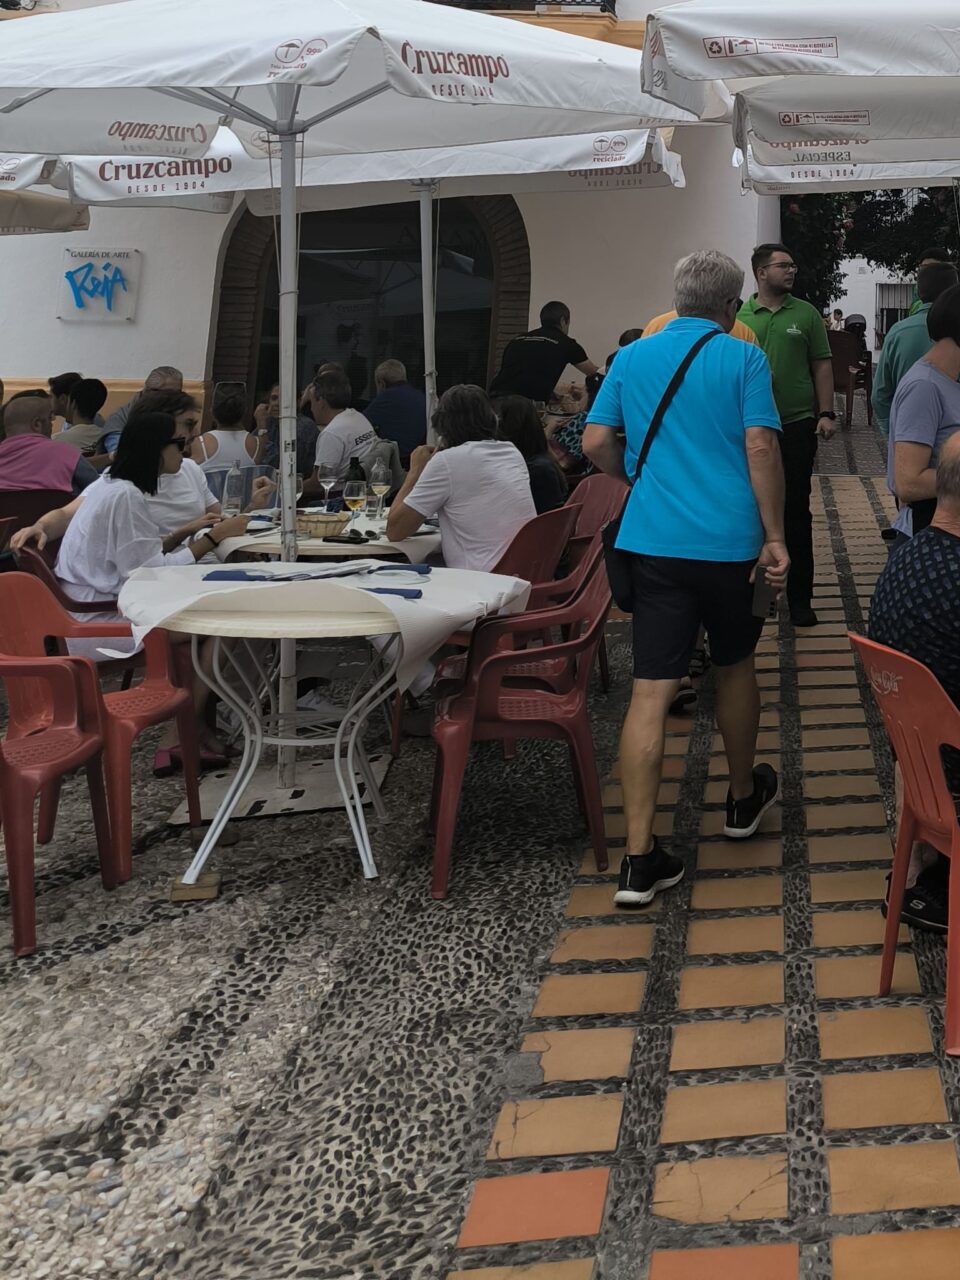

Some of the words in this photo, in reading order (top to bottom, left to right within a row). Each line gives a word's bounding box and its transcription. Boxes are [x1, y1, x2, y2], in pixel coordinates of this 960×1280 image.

[401, 40, 510, 83] Cruzcampo
[98, 156, 232, 182] Cruzcampo
[127, 184, 166, 194] DESDE
[175, 181, 206, 191] 1904
[71, 250, 100, 258] GALERÍA
